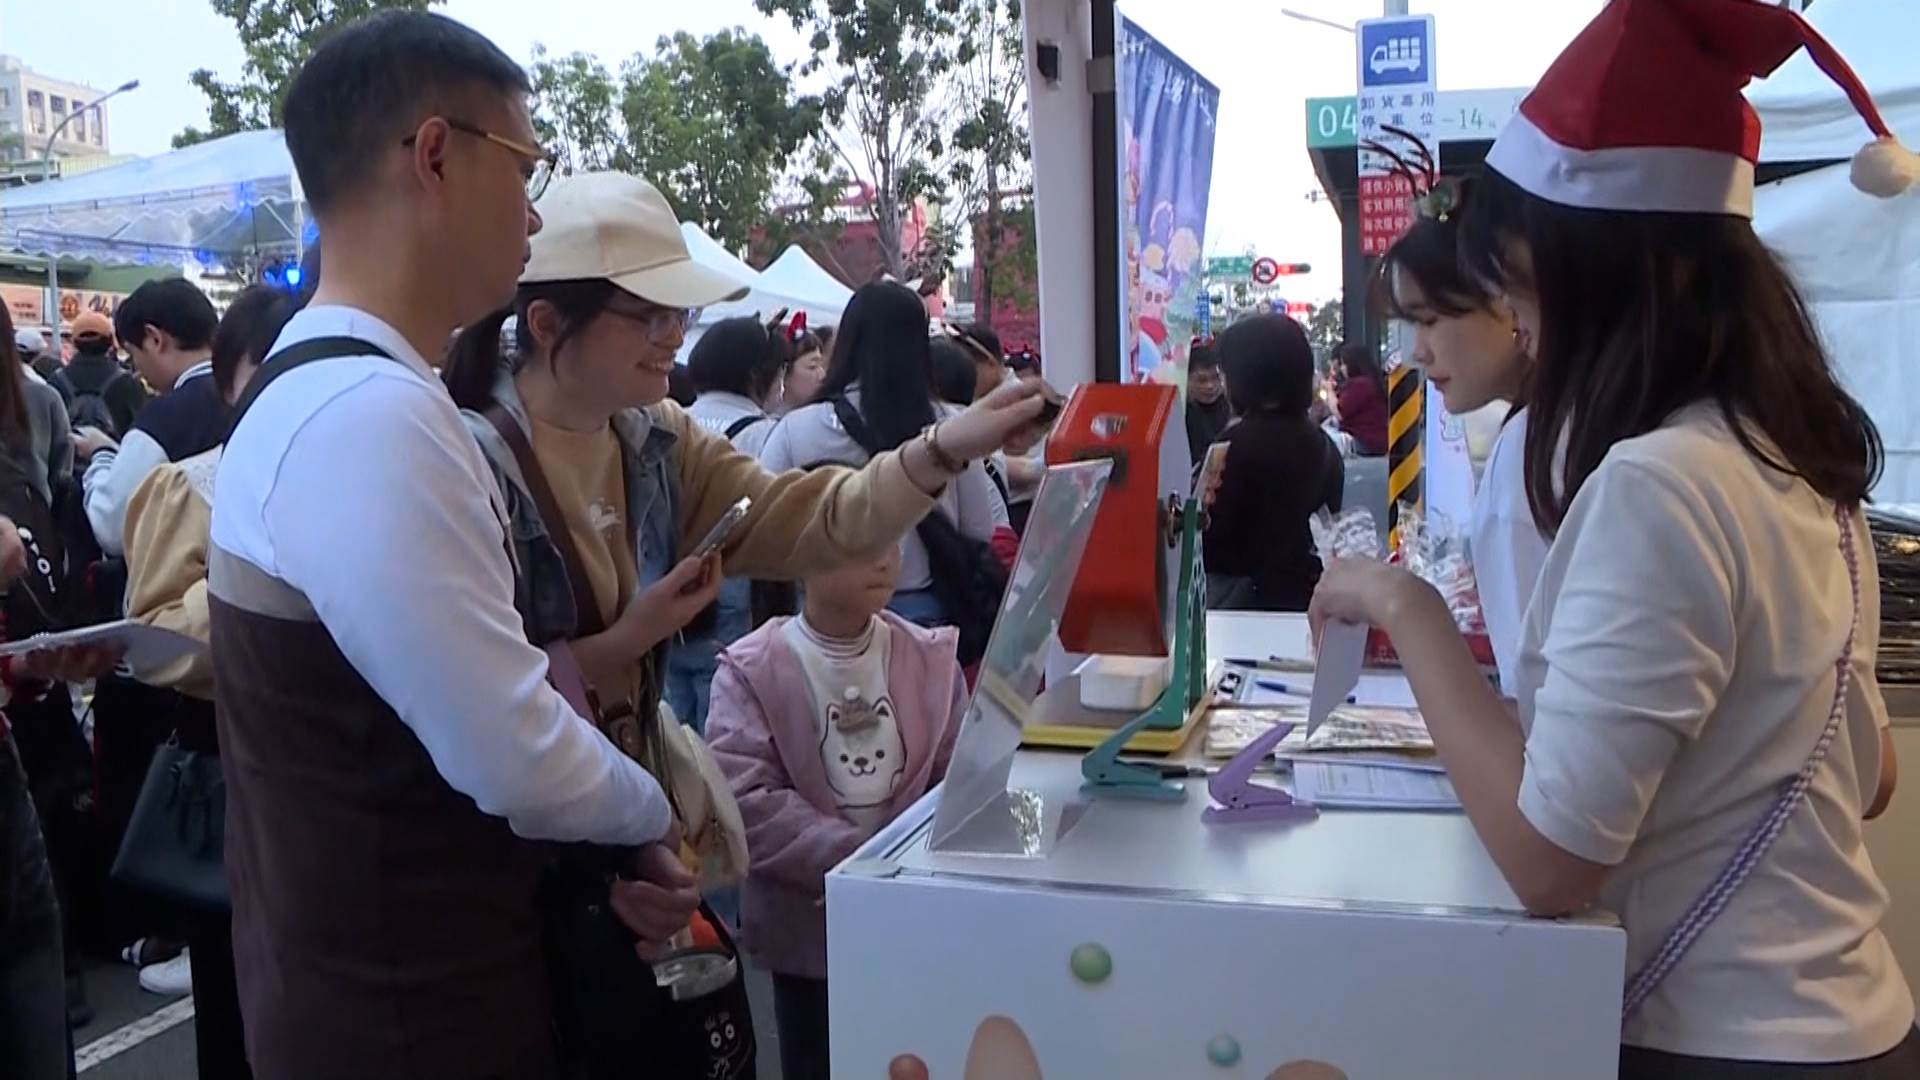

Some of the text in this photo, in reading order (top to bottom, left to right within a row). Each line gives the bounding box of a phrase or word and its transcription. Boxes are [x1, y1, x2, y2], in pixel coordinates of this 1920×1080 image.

[1318, 104, 1358, 138] 04
[1362, 112, 1433, 129] 停車位
